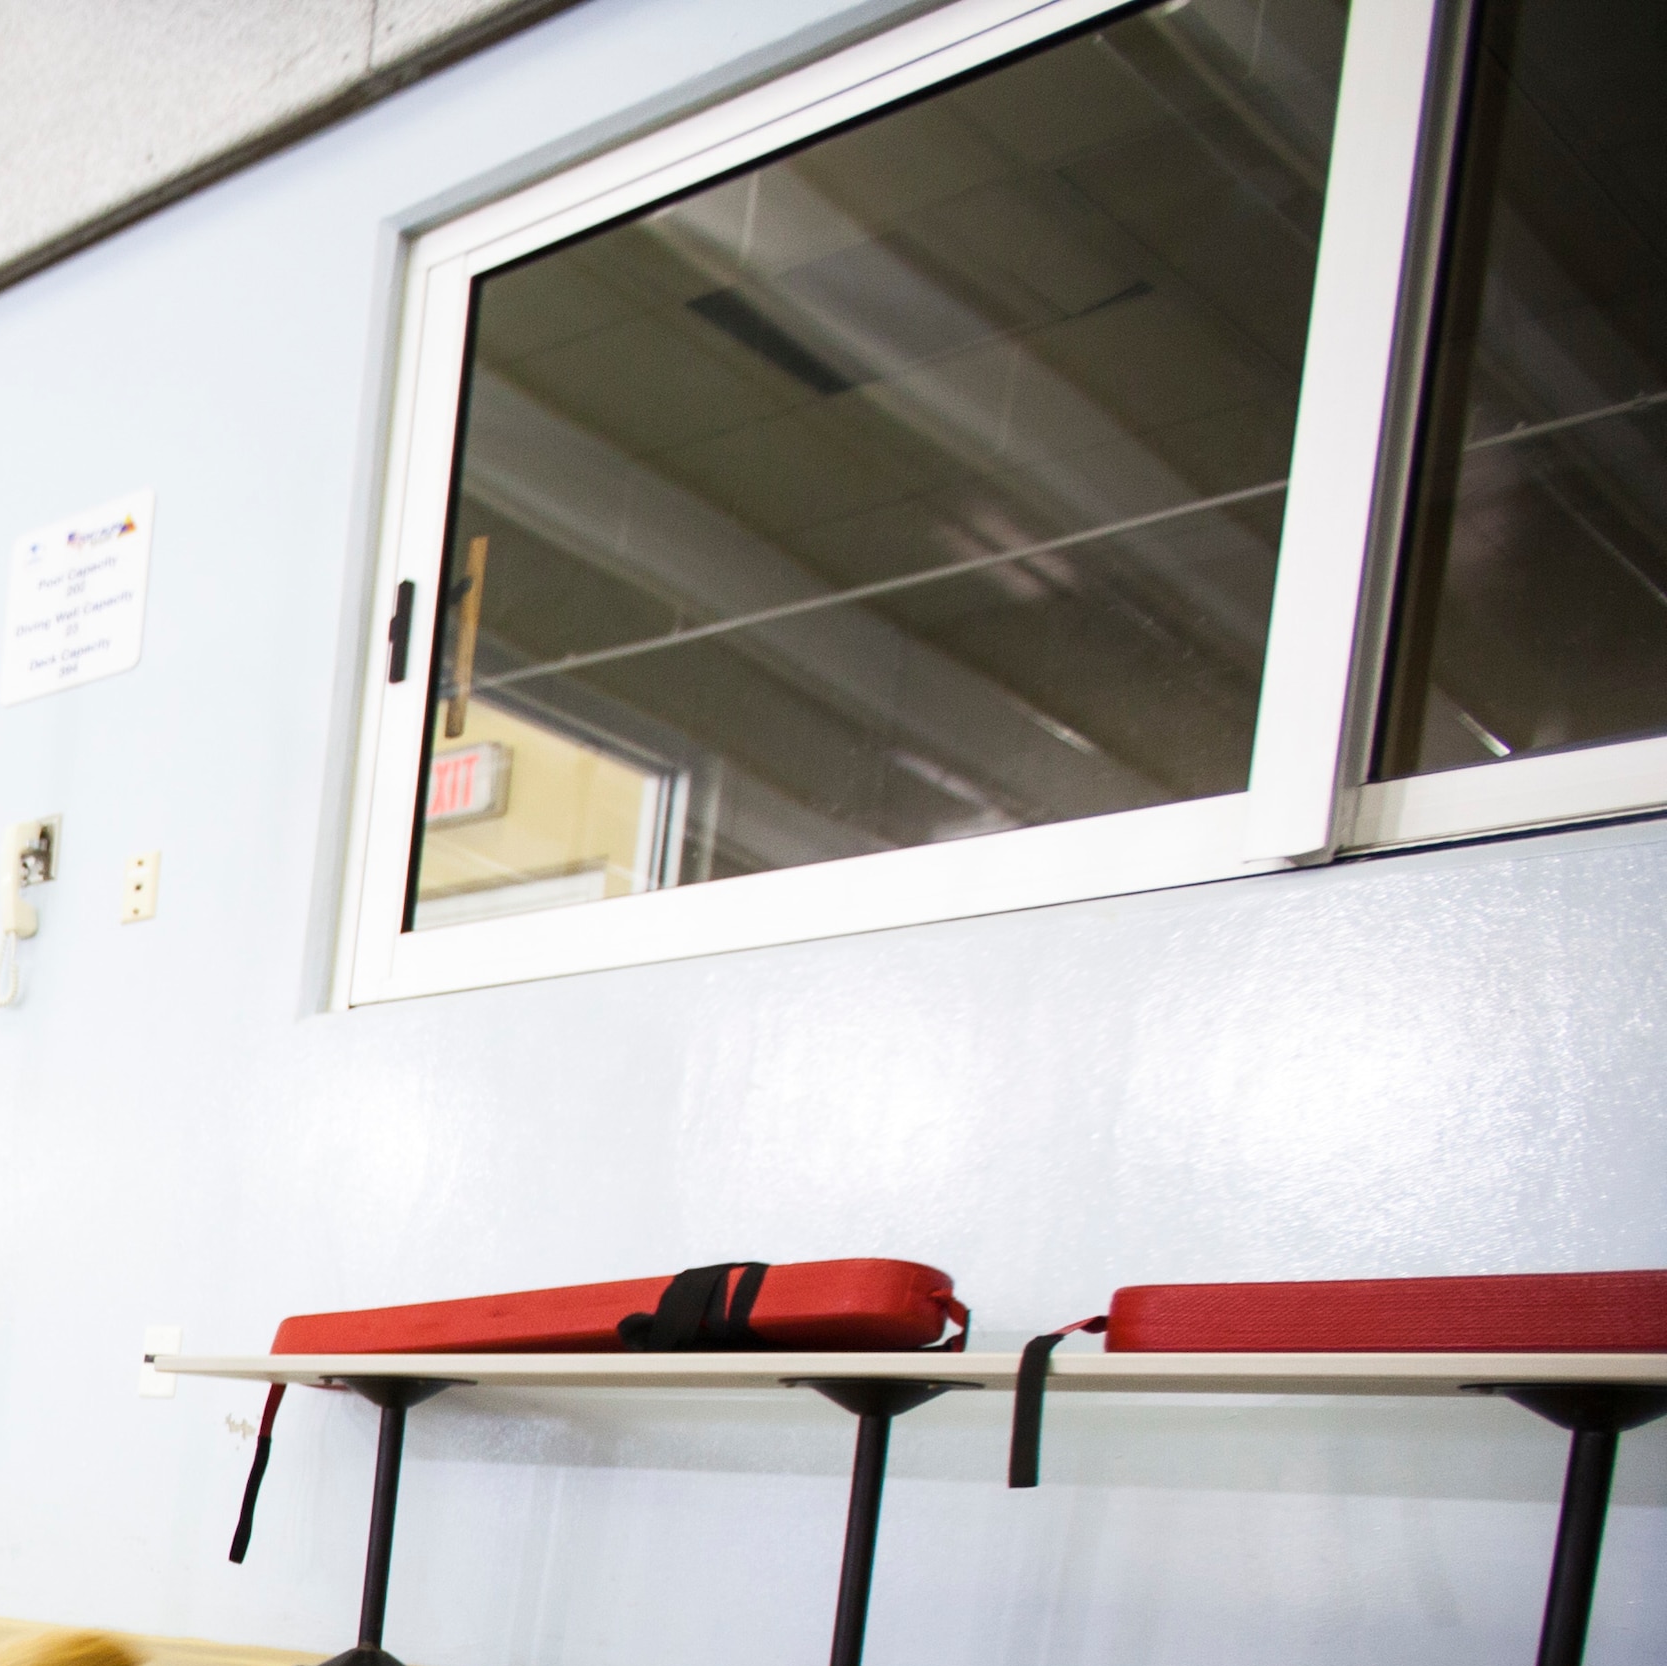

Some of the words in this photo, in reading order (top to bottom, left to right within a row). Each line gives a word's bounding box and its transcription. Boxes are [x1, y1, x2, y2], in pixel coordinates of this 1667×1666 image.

[67, 555, 117, 580] Capacity
[83, 591, 133, 615] Capacity
[61, 639, 110, 661] Capacity
[426, 754, 480, 816] XIT
